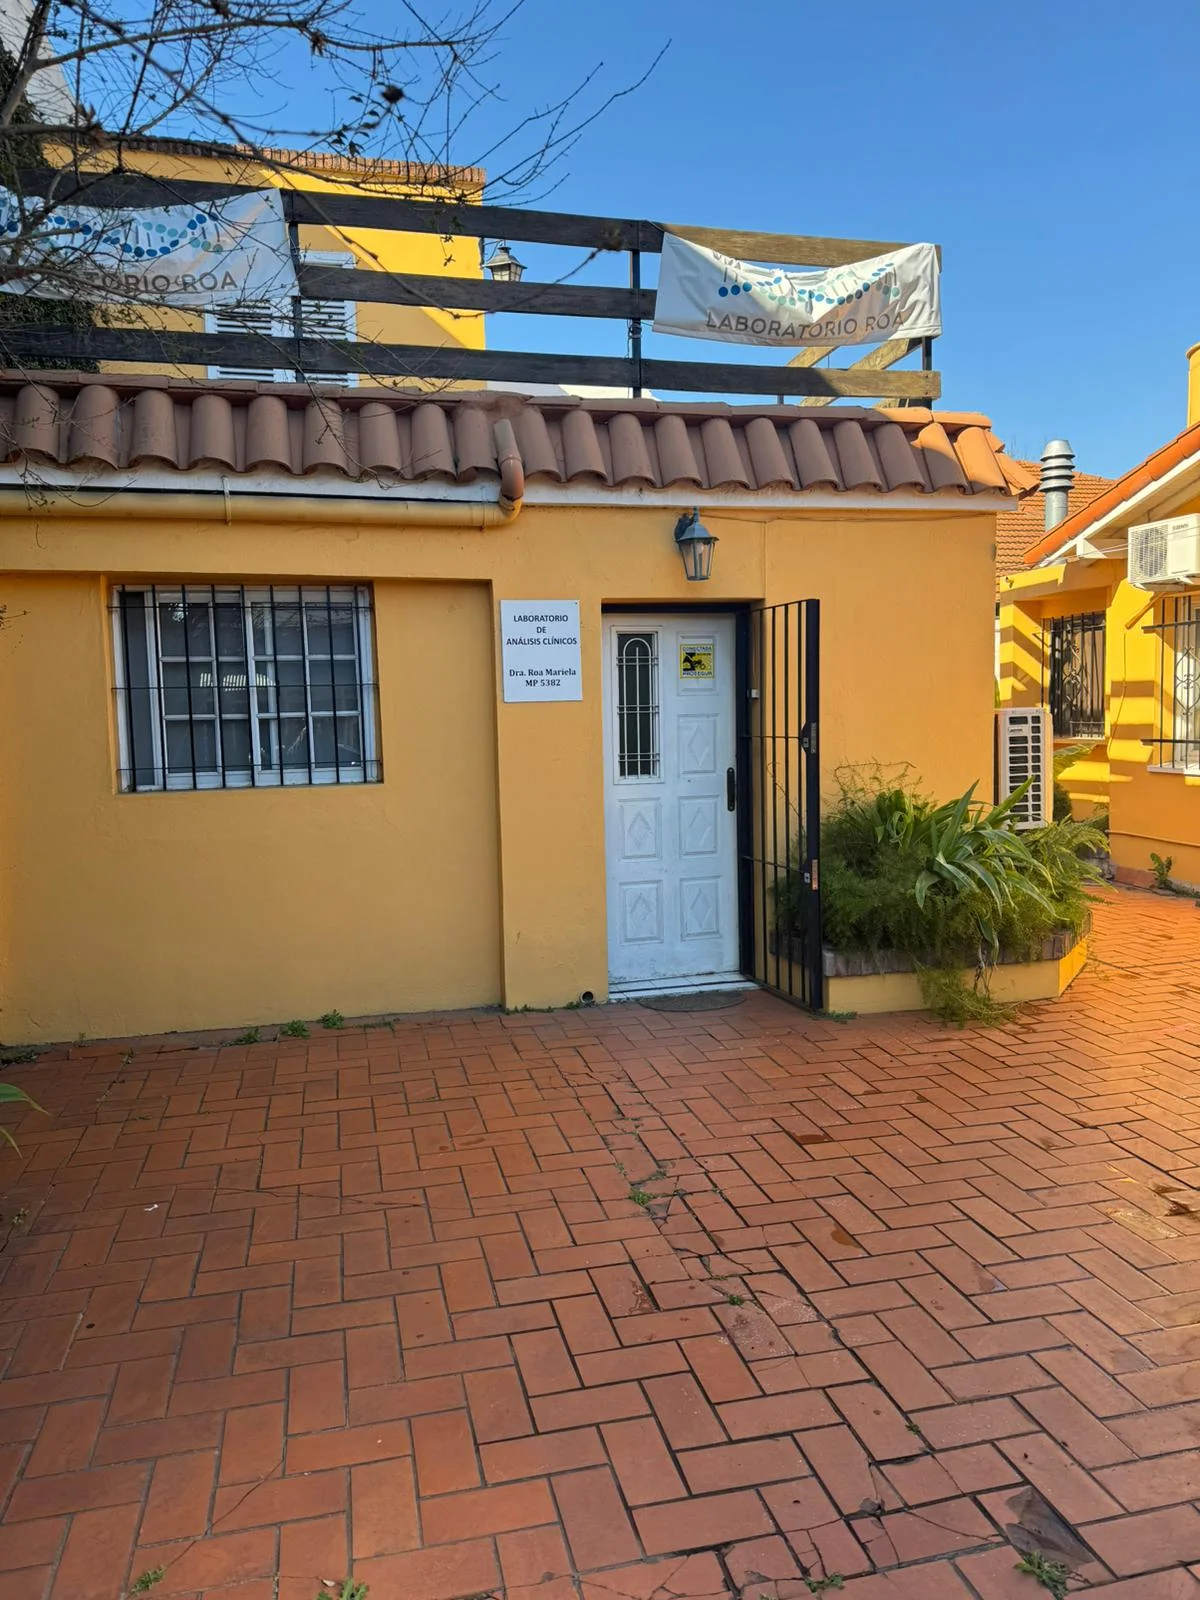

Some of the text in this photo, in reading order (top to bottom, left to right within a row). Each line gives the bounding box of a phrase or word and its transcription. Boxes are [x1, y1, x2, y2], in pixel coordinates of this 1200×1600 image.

[181, 270, 238, 292] ROA
[706, 311, 905, 339] LABORATORIO ROA
[513, 614, 569, 622] LABORATORIO
[536, 626, 547, 634] DE
[506, 635, 578, 645] ANÁLISIS CLÍNICOS
[509, 667, 577, 677] Dra. Roa Mariela
[525, 679, 561, 687] MP 5382
